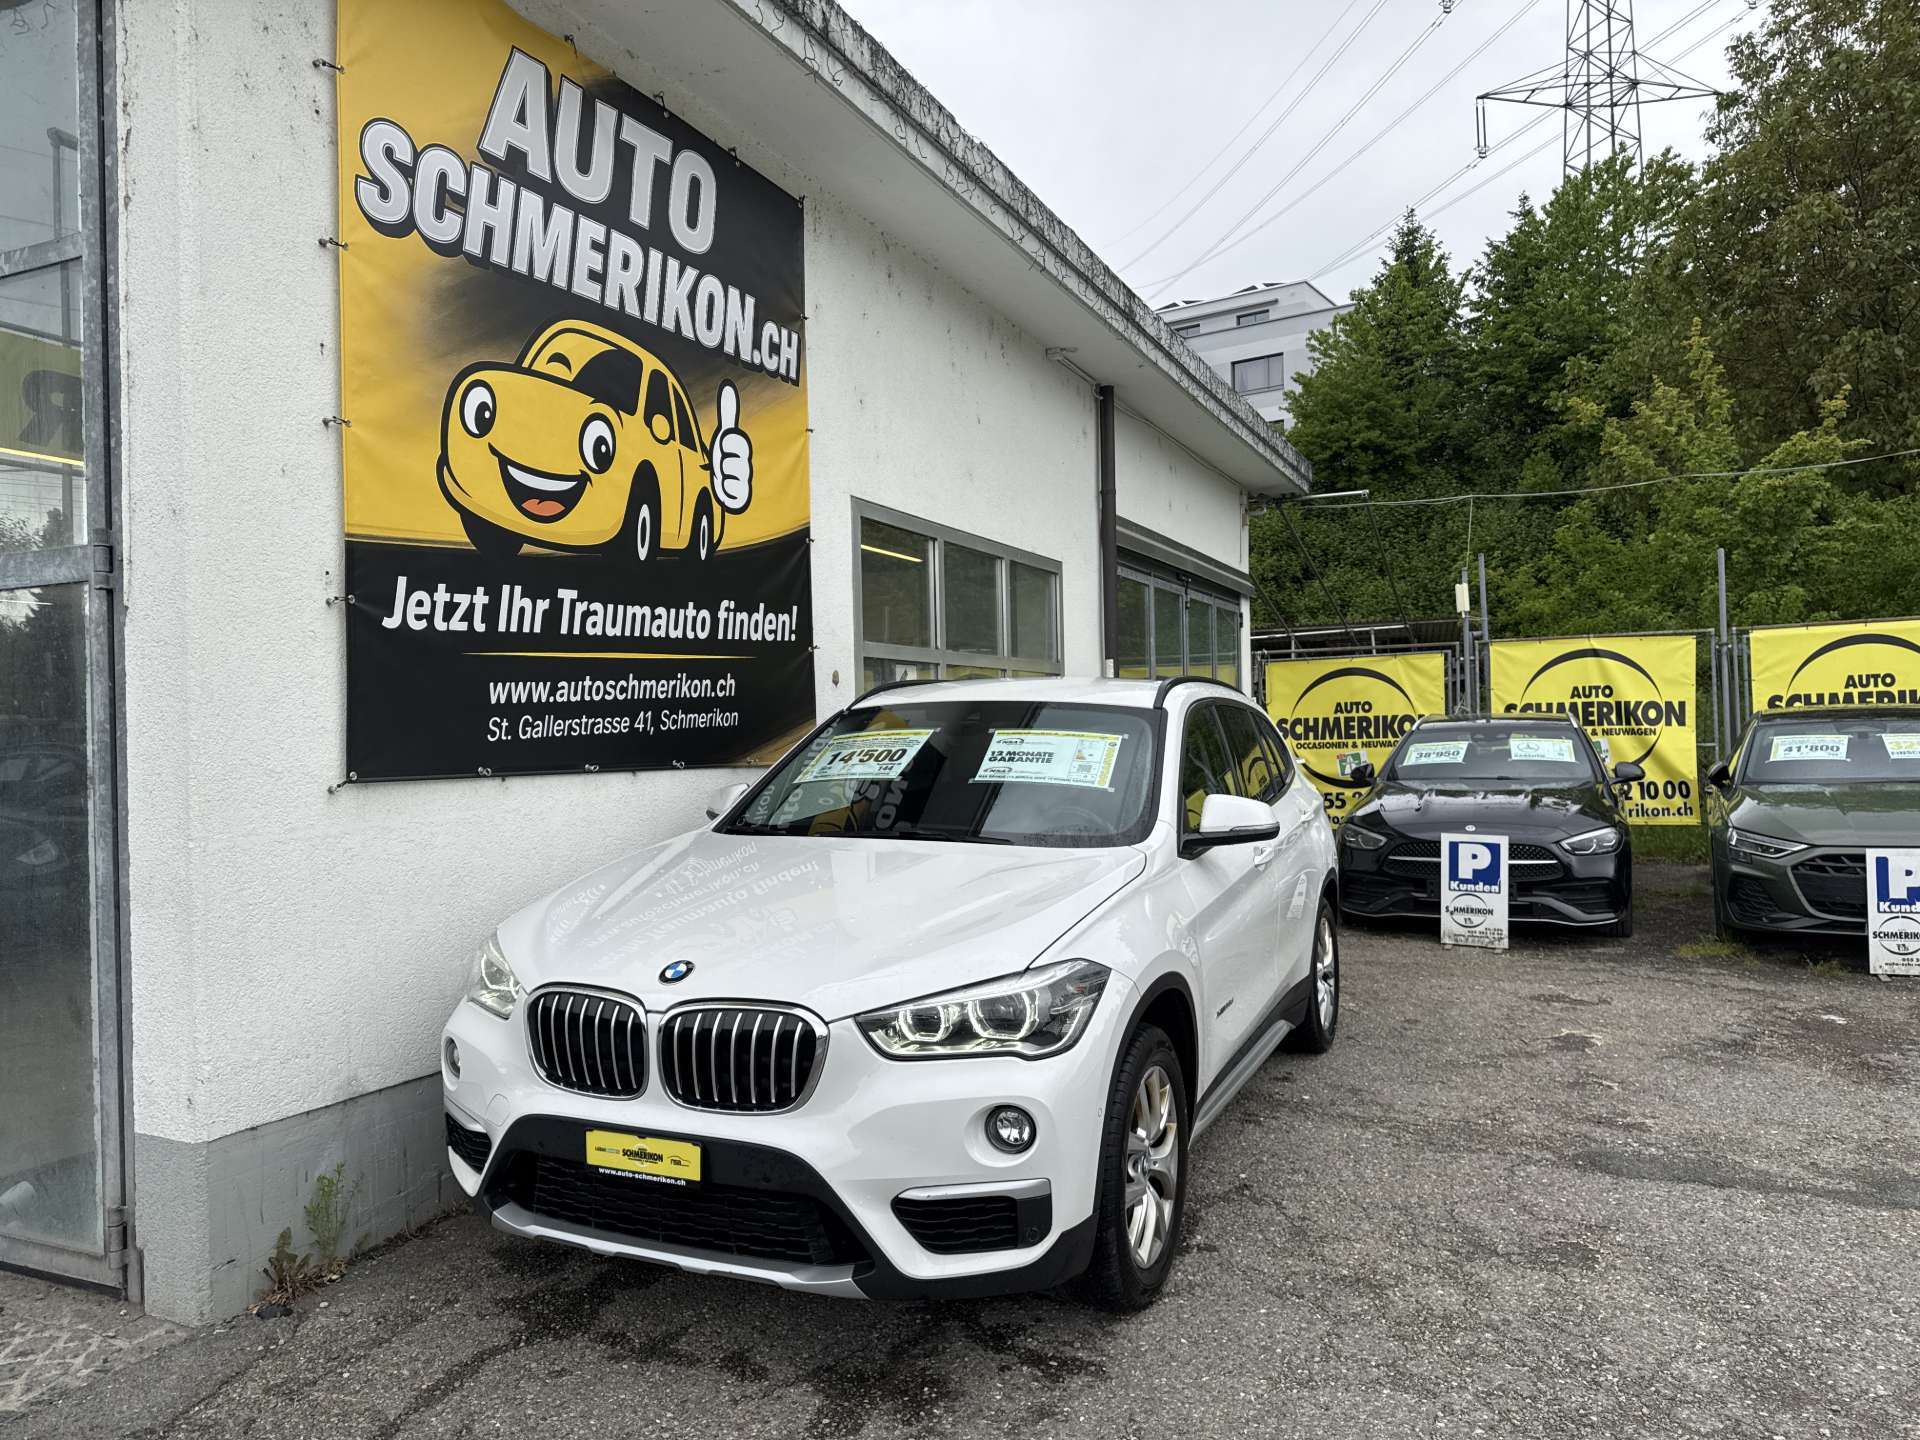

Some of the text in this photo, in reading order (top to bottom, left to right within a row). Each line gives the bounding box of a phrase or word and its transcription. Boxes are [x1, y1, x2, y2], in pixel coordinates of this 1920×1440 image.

[478, 46, 717, 255] AUTO
[357, 119, 800, 382] SCHMERIKON.CH
[382, 575, 798, 642] Jetzt Ihr Traumauto finden!
[489, 673, 736, 704] www.autoschmerikon.ch
[1844, 673, 1896, 689] AUTO
[1570, 685, 1614, 699] AUTO
[1334, 701, 1373, 714] AUTO
[487, 708, 739, 742] St. Gallerstrasse 41, Schmerikon
[1276, 714, 1426, 741] SCHMERIKO
[1602, 728, 1657, 736] NEUWAGEN
[1296, 740, 1349, 749] OCCASIONEN
[827, 748, 908, 765] 14'500
[988, 756, 1054, 764] GARANTIE
[1005, 750, 1055, 758] MONATE
[1638, 781, 1659, 800] 10
[1663, 780, 1691, 799] 00
[1323, 791, 1347, 809] 55
[1458, 843, 1492, 880] P
[1449, 881, 1499, 893] Kunden
[1880, 900, 1920, 913] Kund
[1872, 930, 1920, 940] SCHMERIK
[622, 1148, 663, 1162] SCHMERIKON
[598, 1167, 686, 1186] www.auto-schmerikon.ch
